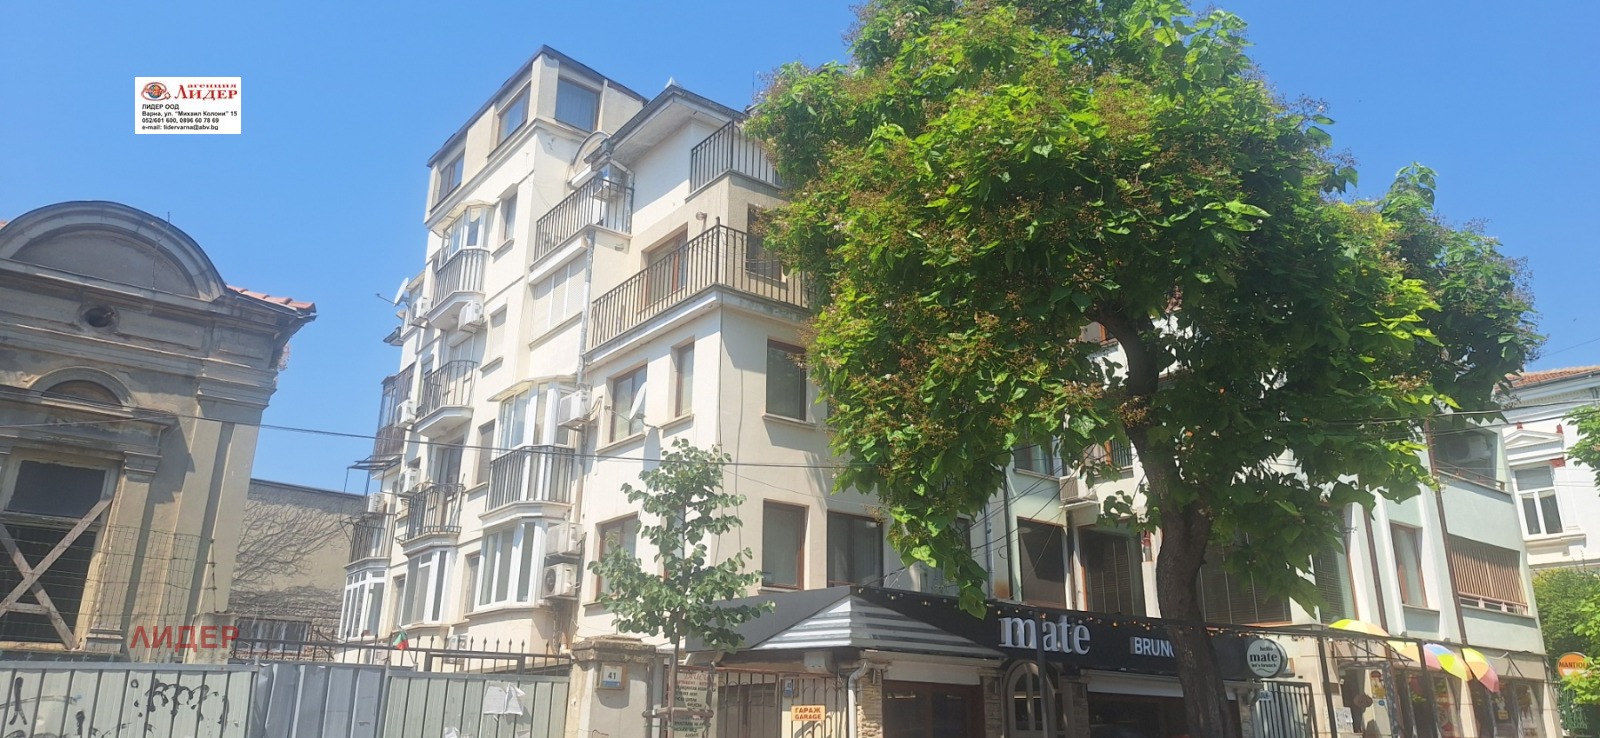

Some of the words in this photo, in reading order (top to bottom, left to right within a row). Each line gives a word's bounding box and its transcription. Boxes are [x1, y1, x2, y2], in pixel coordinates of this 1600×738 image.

[998, 615, 1091, 655] mate
[1250, 652, 1278, 662] mate
[607, 671, 617, 680] 41
